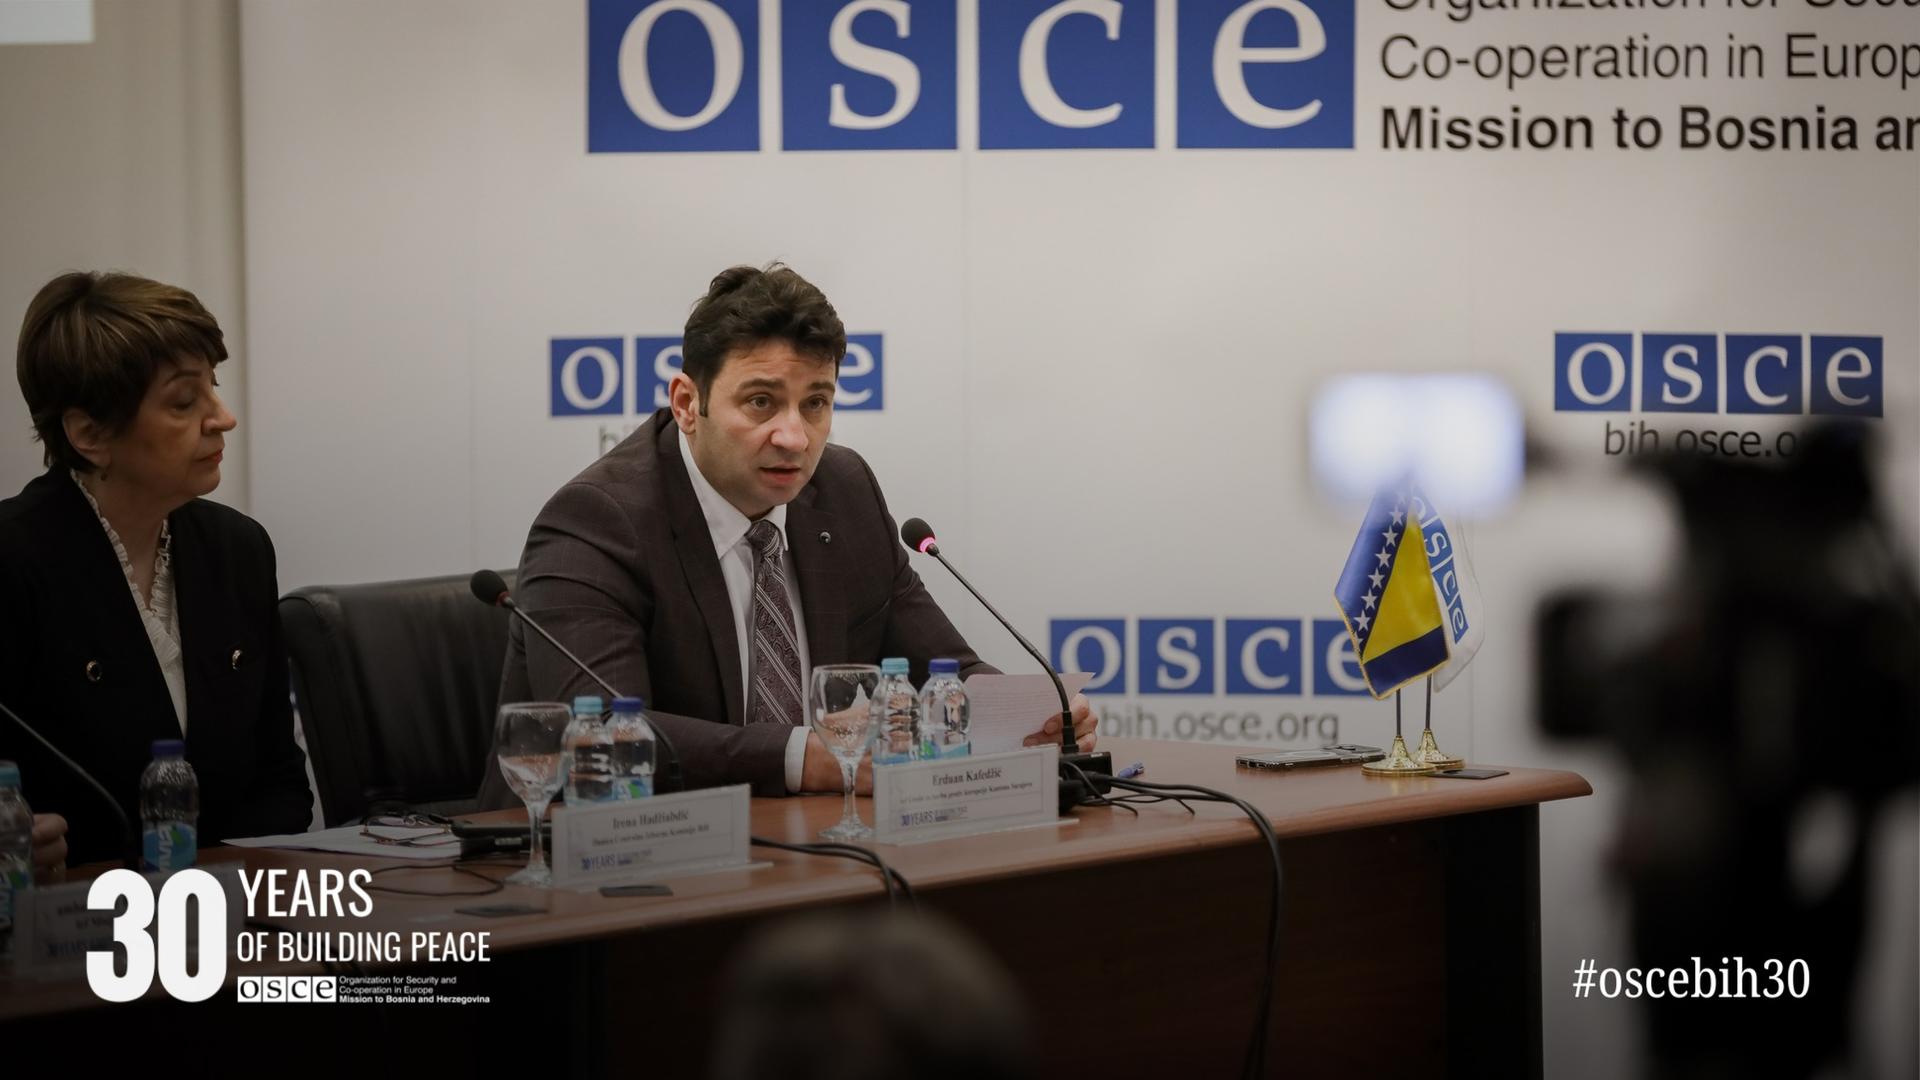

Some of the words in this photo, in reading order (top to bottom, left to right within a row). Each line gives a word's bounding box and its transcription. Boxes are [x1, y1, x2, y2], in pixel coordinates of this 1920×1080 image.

[1381, 33, 1708, 90] Co-operation
[1728, 33, 1765, 79] in
[1382, 106, 1594, 151] Mission
[1613, 108, 1662, 151] to
[1680, 106, 1860, 151] Bosnia
[1567, 342, 1872, 406] osce
[1101, 704, 1340, 742] bih.osce.org
